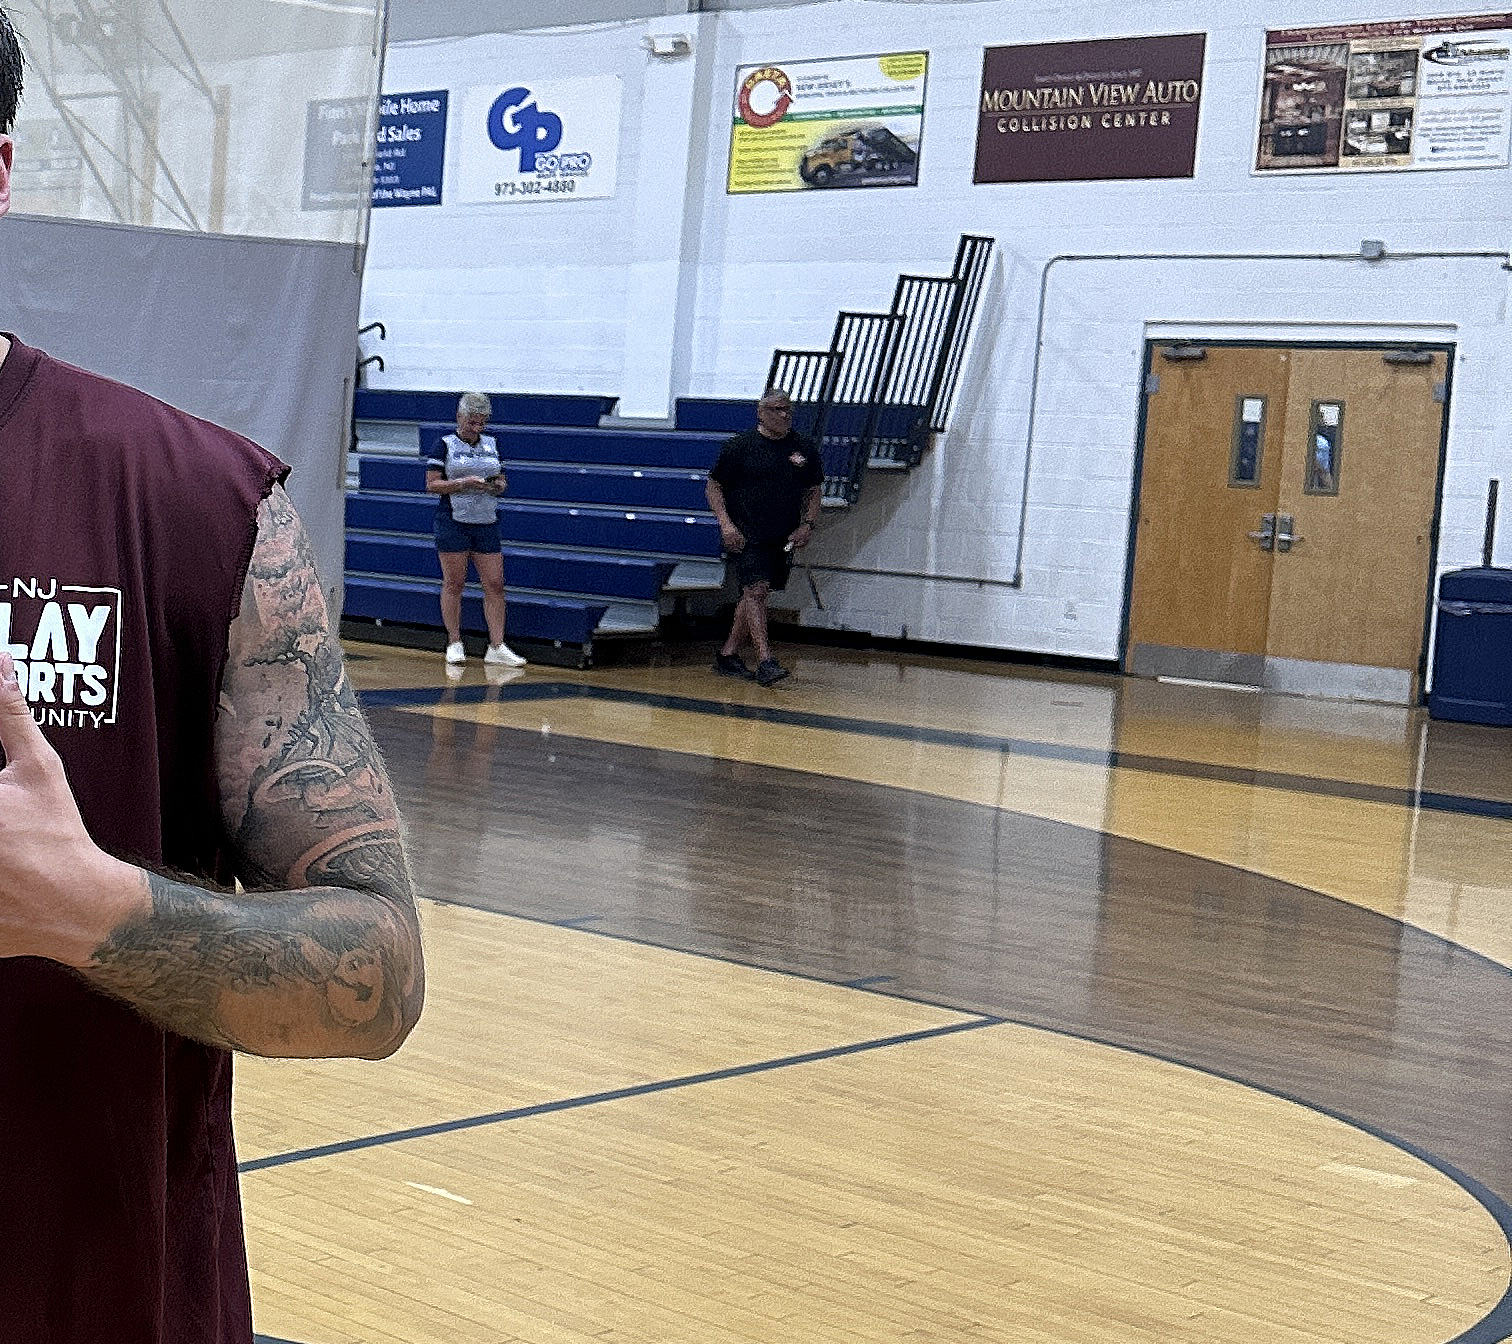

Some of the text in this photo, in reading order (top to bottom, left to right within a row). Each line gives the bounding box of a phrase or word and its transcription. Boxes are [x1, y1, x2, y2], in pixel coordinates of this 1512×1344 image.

[400, 98, 441, 115] Home
[982, 80, 1199, 112] MOUNTAIN VIEW AUTO
[387, 124, 422, 143] Sales
[997, 111, 1171, 134] COLLISION CENTER
[12, 577, 57, 600] NJ
